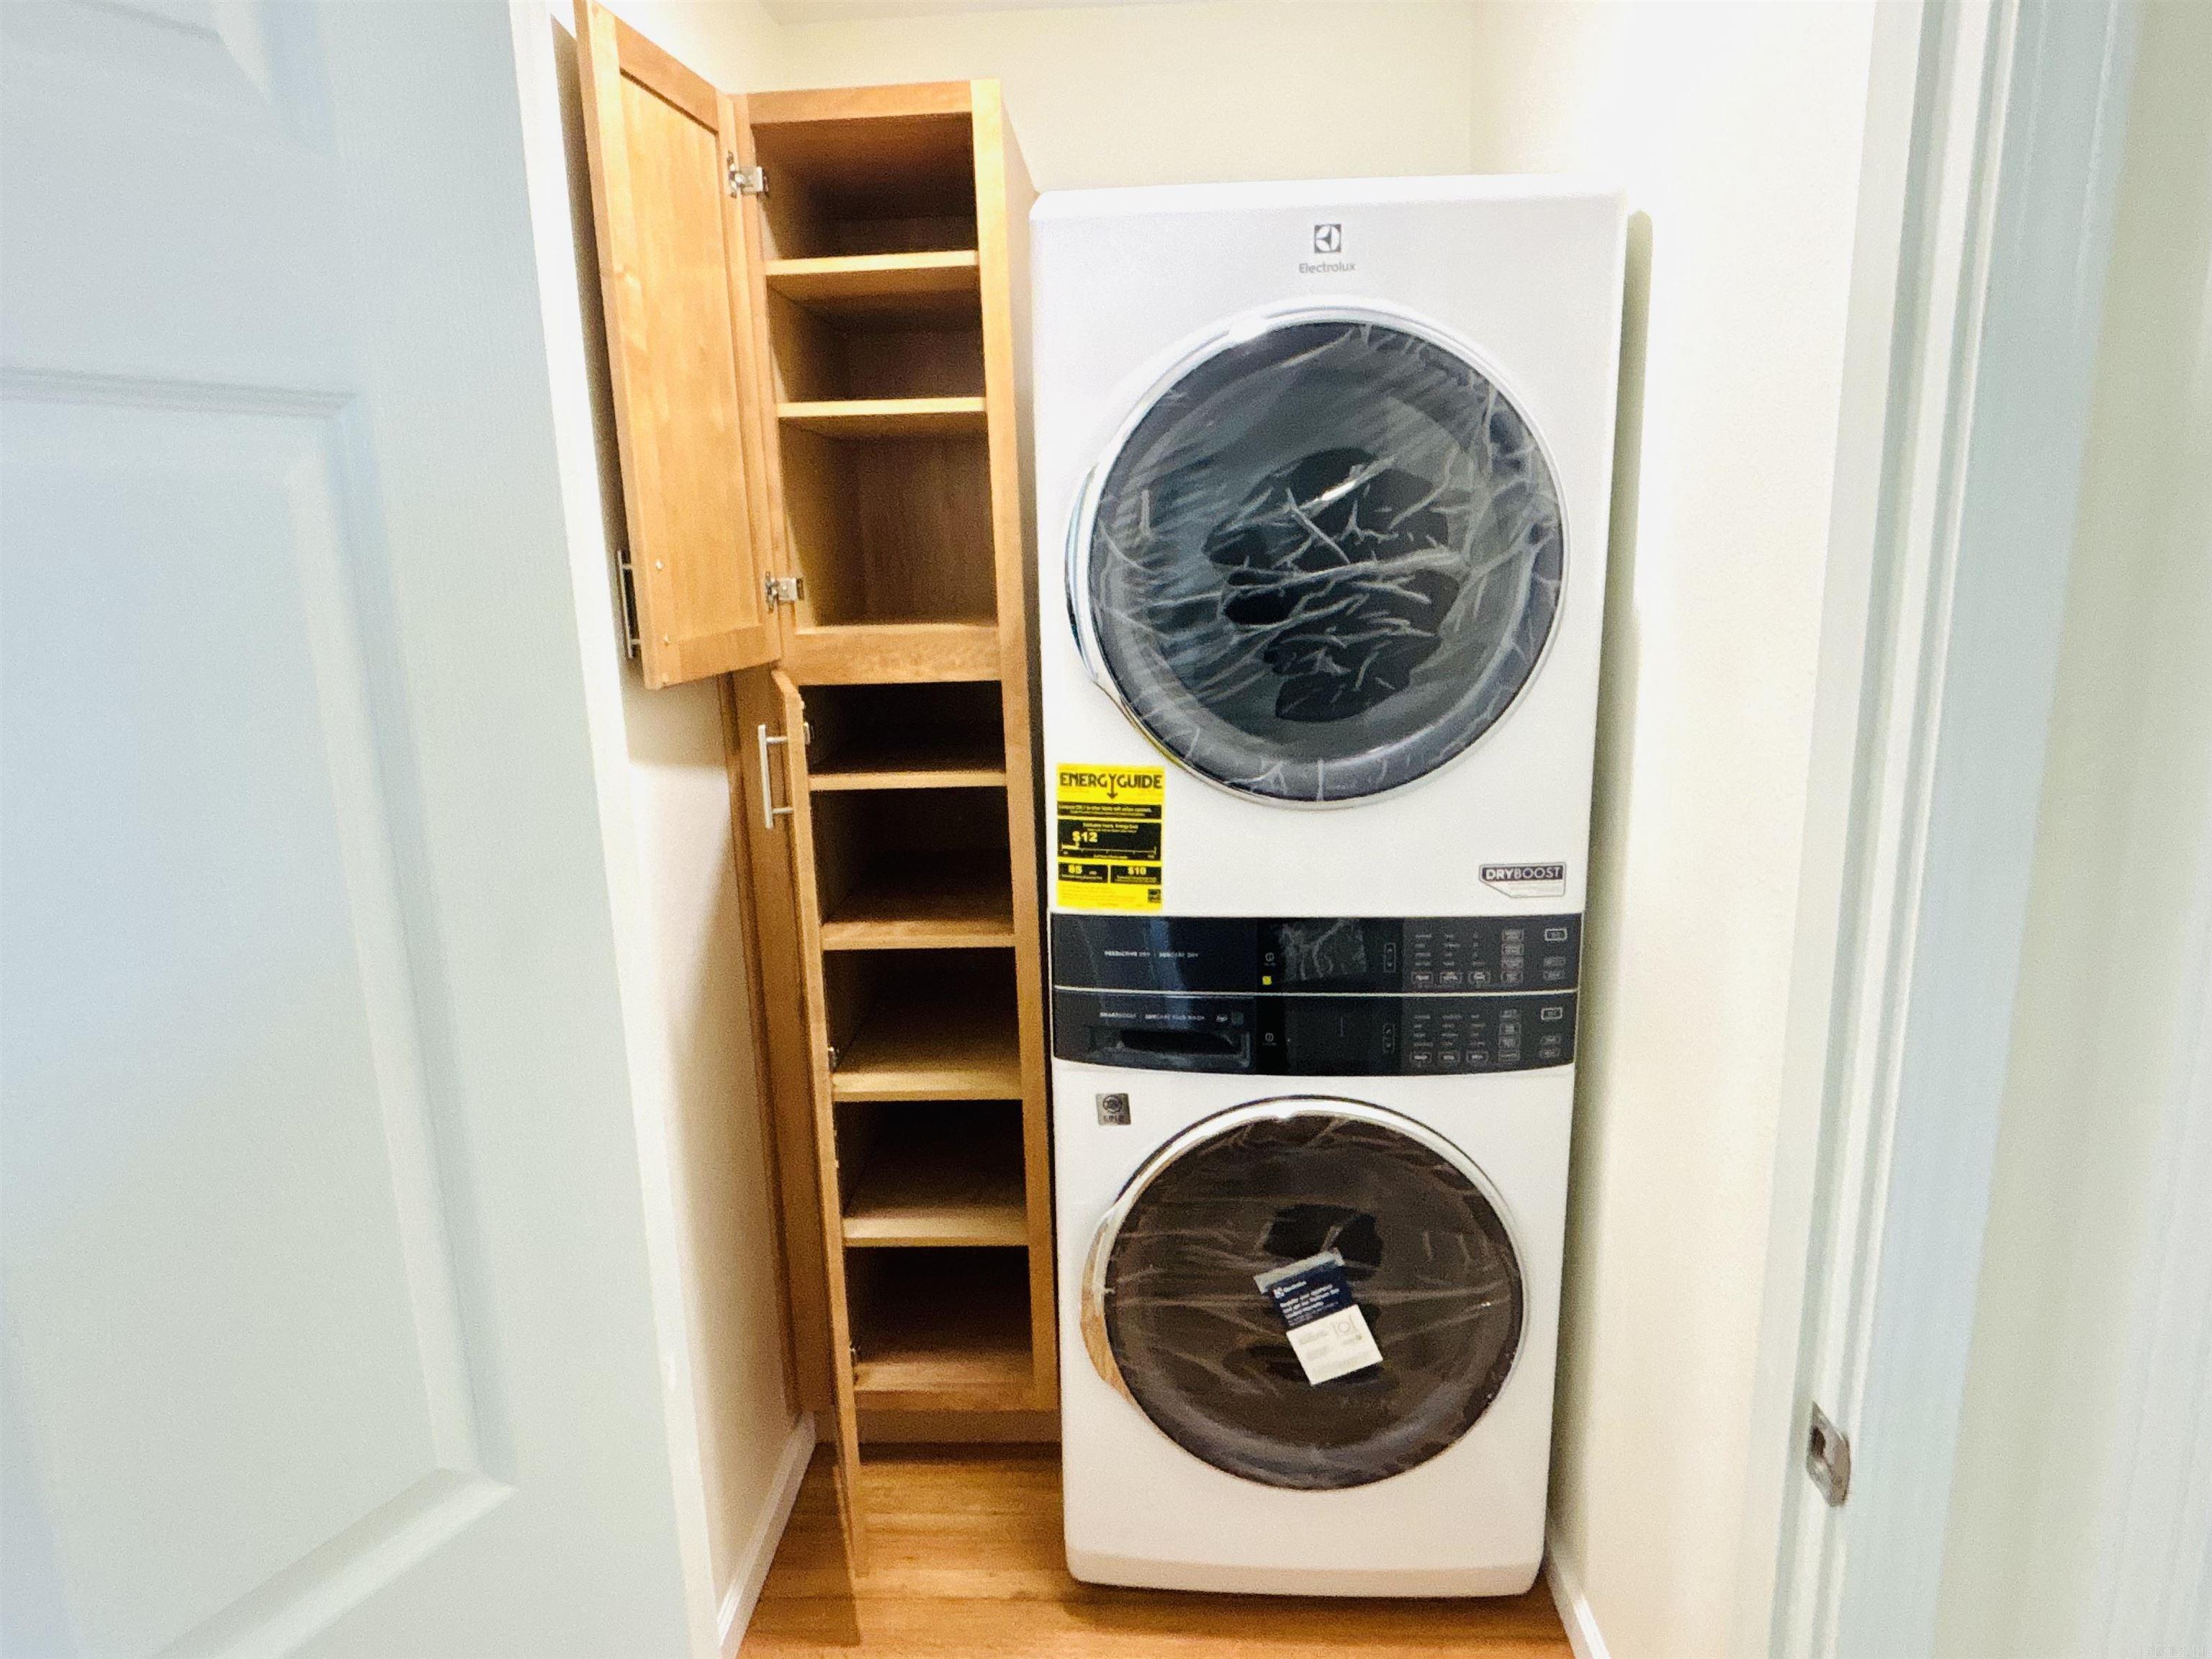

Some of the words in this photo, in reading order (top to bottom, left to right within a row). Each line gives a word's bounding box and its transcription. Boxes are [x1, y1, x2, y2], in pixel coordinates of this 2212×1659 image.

[1299, 261, 1356, 274] Electrolux
[1059, 772, 1163, 791] ENERGYGUIDE
[1072, 831, 1098, 842] $12
[1485, 867, 1560, 879] DRYBOOST
